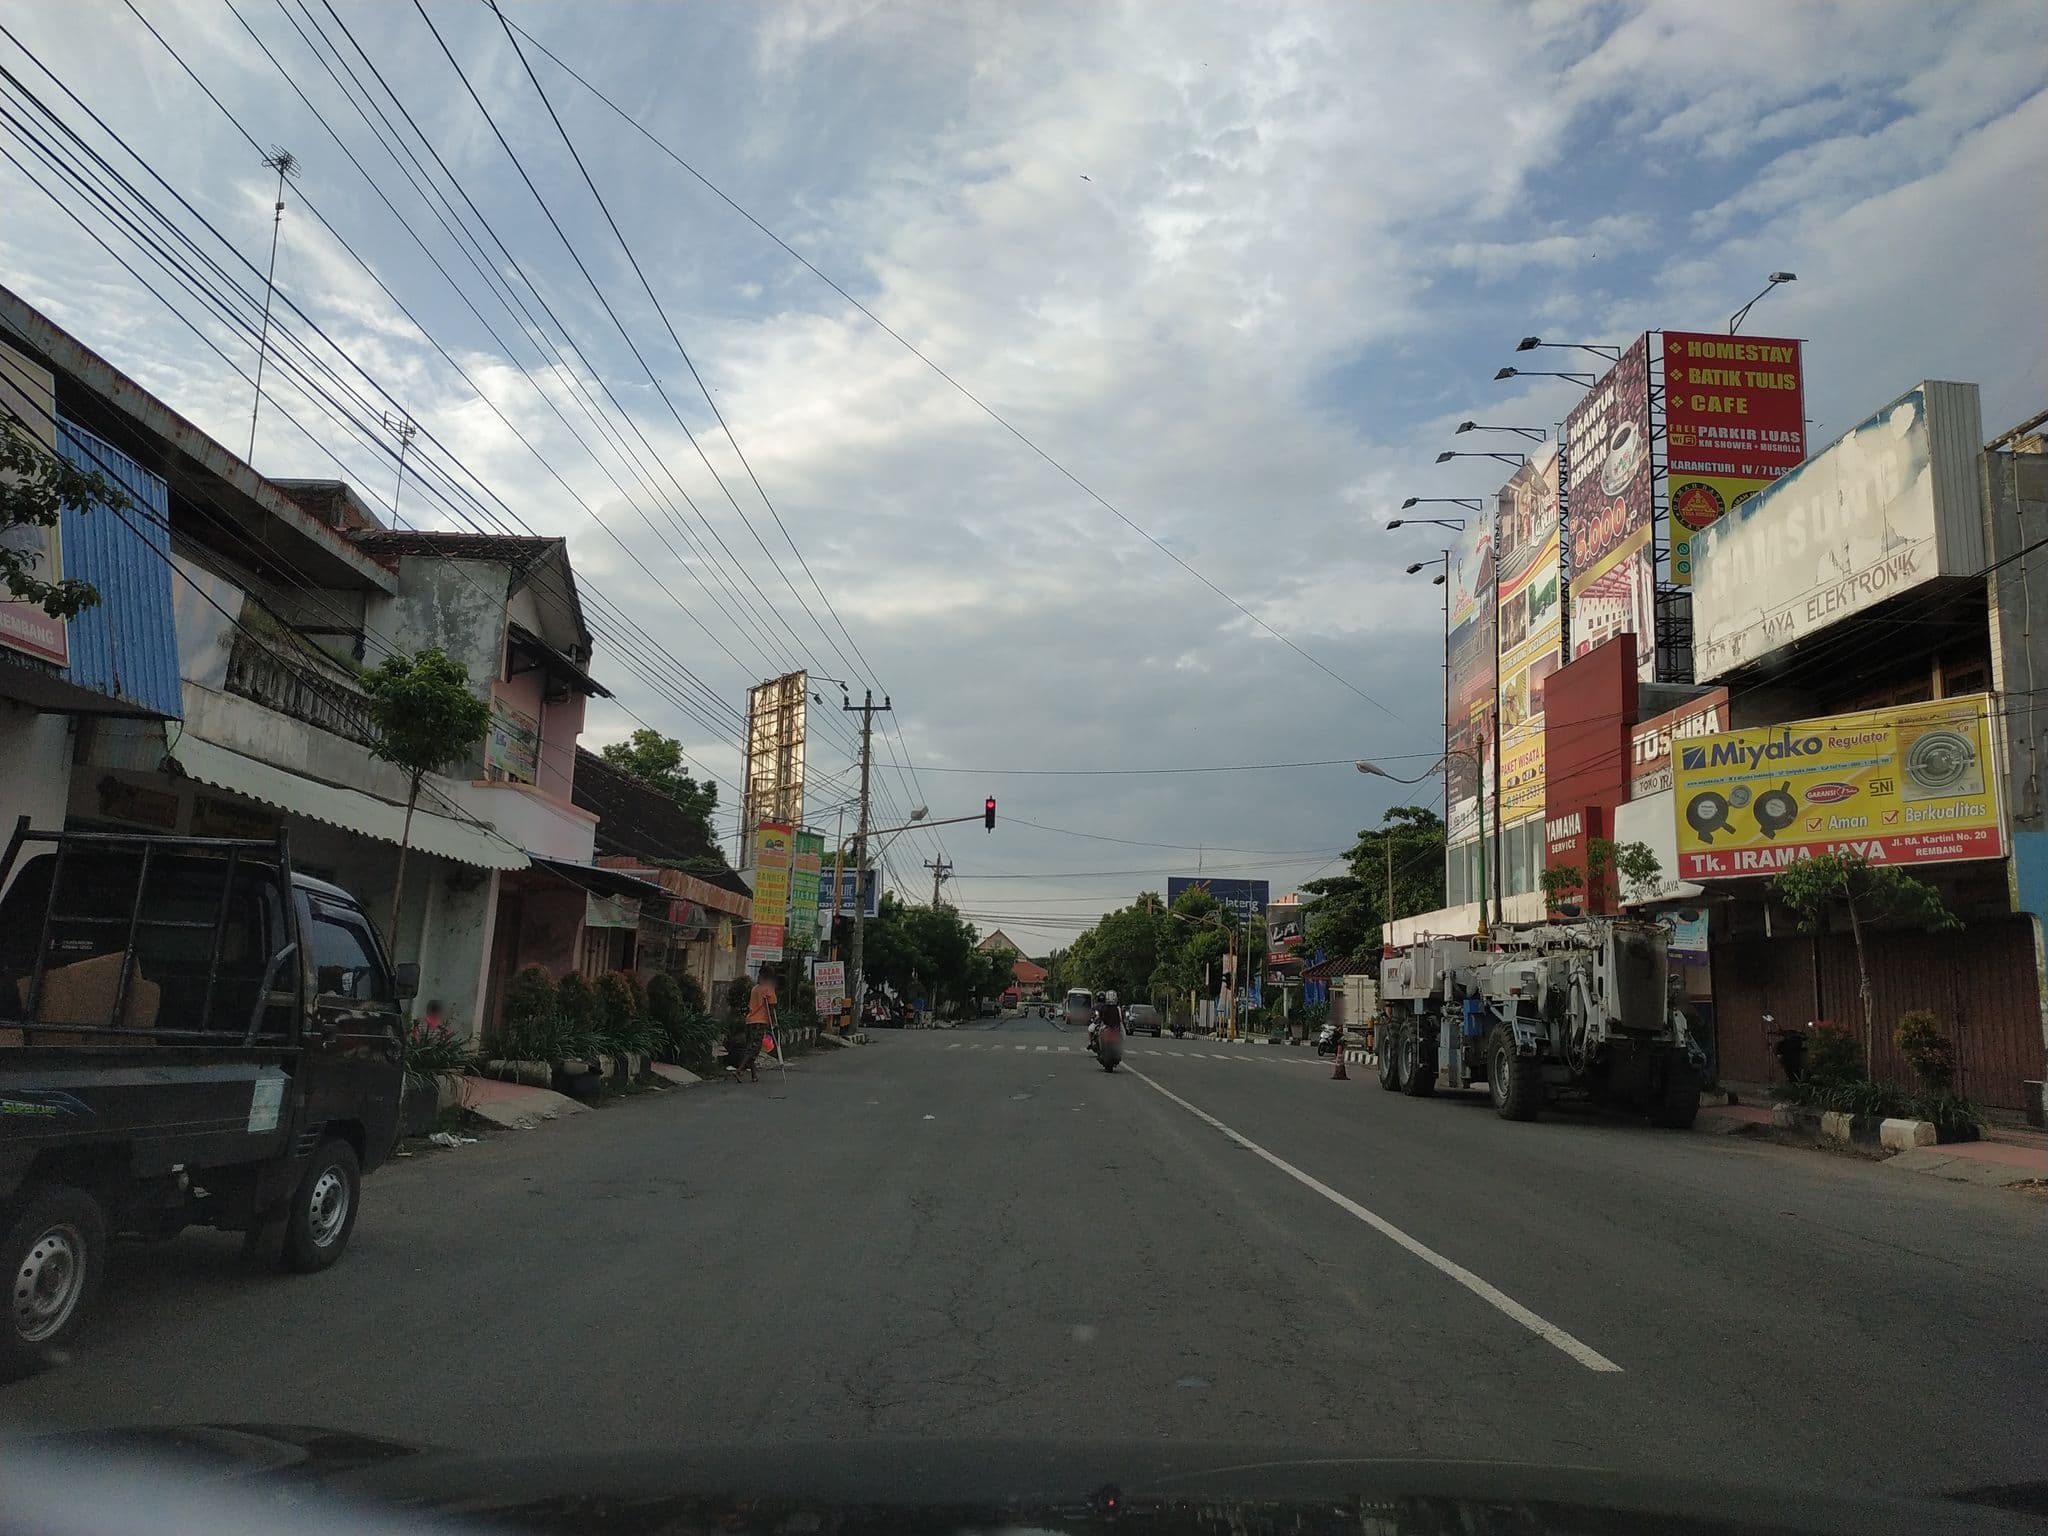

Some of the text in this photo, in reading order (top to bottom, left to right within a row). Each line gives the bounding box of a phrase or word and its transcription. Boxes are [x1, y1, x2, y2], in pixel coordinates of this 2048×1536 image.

[1687, 341, 1793, 363] HOMESTAY
[1688, 368, 1796, 390] BATIK TULIS
[1691, 395, 1748, 414] CAFE
[1570, 386, 1614, 446] NGANTUK
[1669, 424, 1697, 433] FREE
[1698, 426, 1801, 443] PARKIR LUAS
[1570, 416, 1608, 470] HILANG
[1698, 440, 1713, 448] KM
[1715, 441, 1752, 450] SHOWER
[1571, 444, 1607, 491] DENGAN
[1670, 460, 1735, 473] KARANGTURI
[1742, 464, 1752, 474] IV
[1807, 549, 1918, 623] ELEKTRONIK
[1633, 704, 1719, 765] TOSHIBA
[1711, 732, 1823, 771] Miyako
[1828, 731, 1889, 749] Regulator
[1869, 780, 1894, 794] SNI
[1546, 813, 1581, 842] YAMAHA
[1828, 803, 1986, 831] Aman Berkualitas
[1551, 839, 1576, 854] SERVICE
[1891, 830, 1987, 847] Jl. RA. Kartini No. 20
[1691, 855, 1726, 873] Tk.
[1734, 846, 1811, 870] IRAMA
[1916, 845, 1963, 857] REMBANG
[1663, 880, 1680, 893] JAYA
